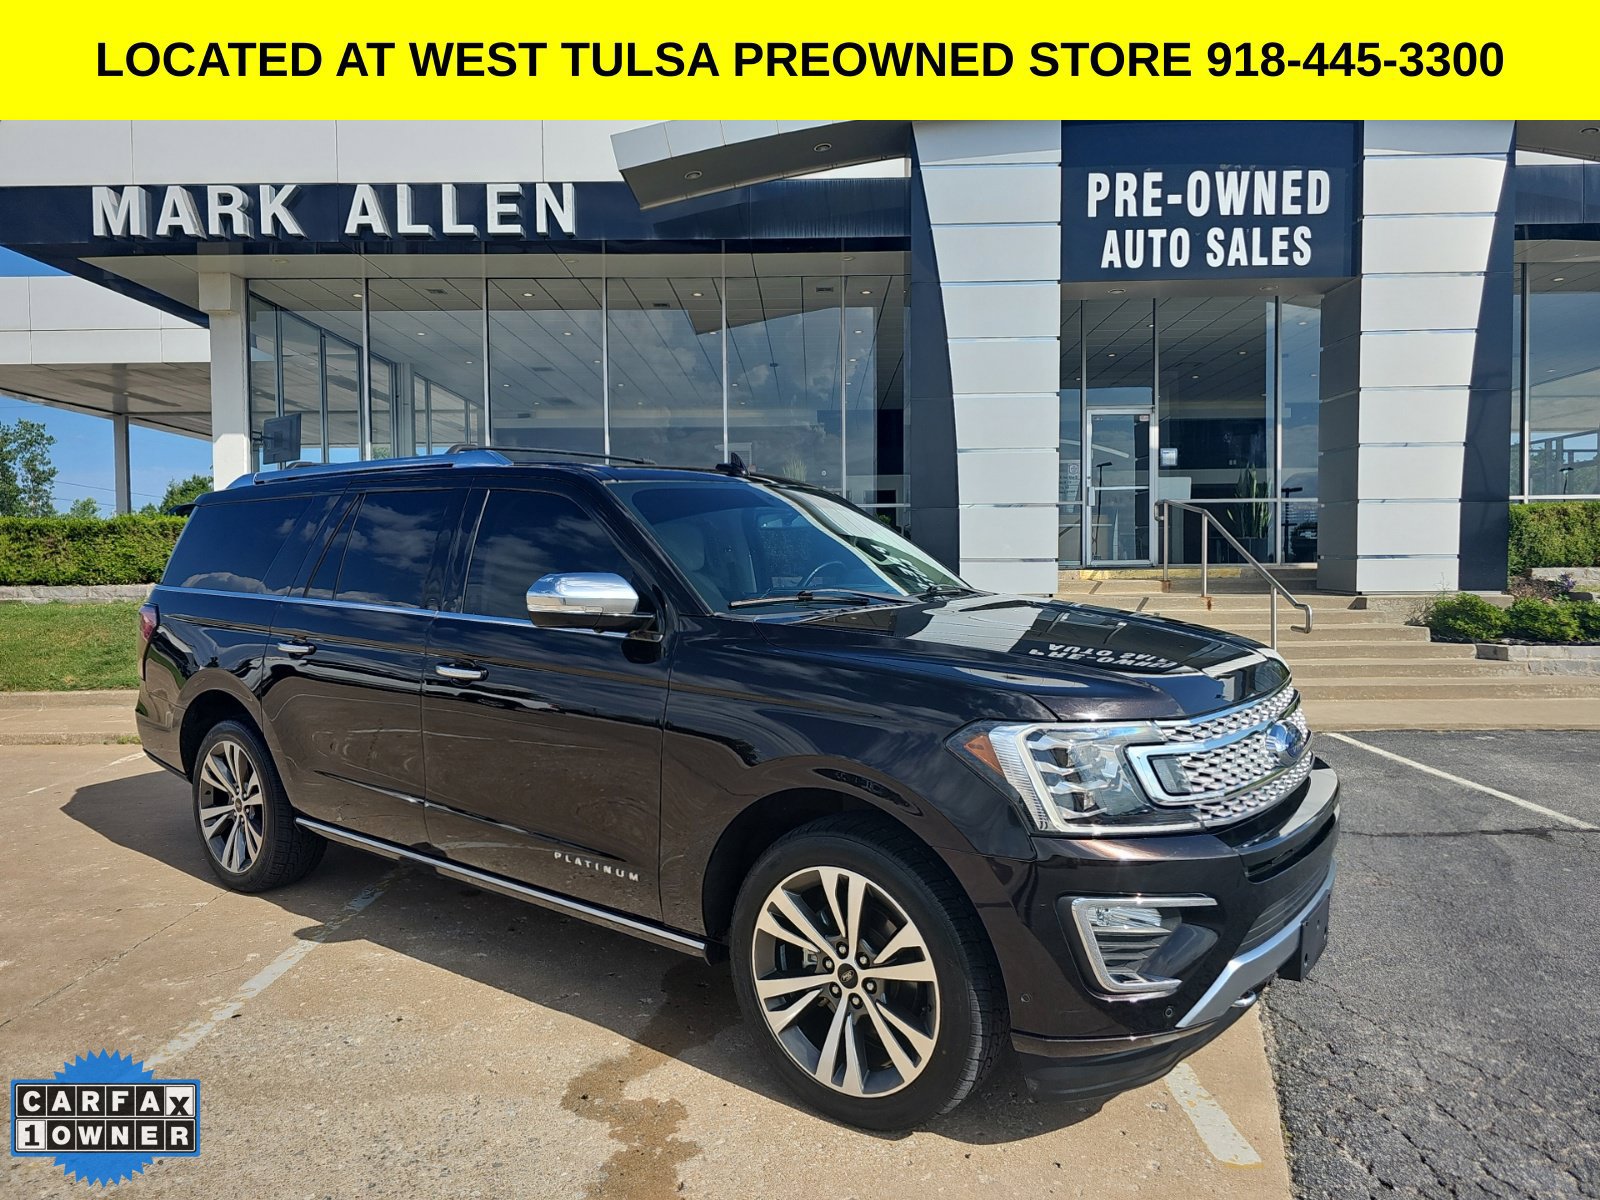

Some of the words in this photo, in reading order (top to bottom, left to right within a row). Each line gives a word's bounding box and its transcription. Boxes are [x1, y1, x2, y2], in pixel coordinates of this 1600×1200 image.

[91, 184, 307, 240] MARK
[344, 183, 577, 238] ALLEN
[1087, 169, 1331, 218] PRE-OWNED
[1100, 226, 1191, 269] AUTO
[1205, 225, 1313, 268] SALES
[554, 851, 639, 881] PLATINUM
